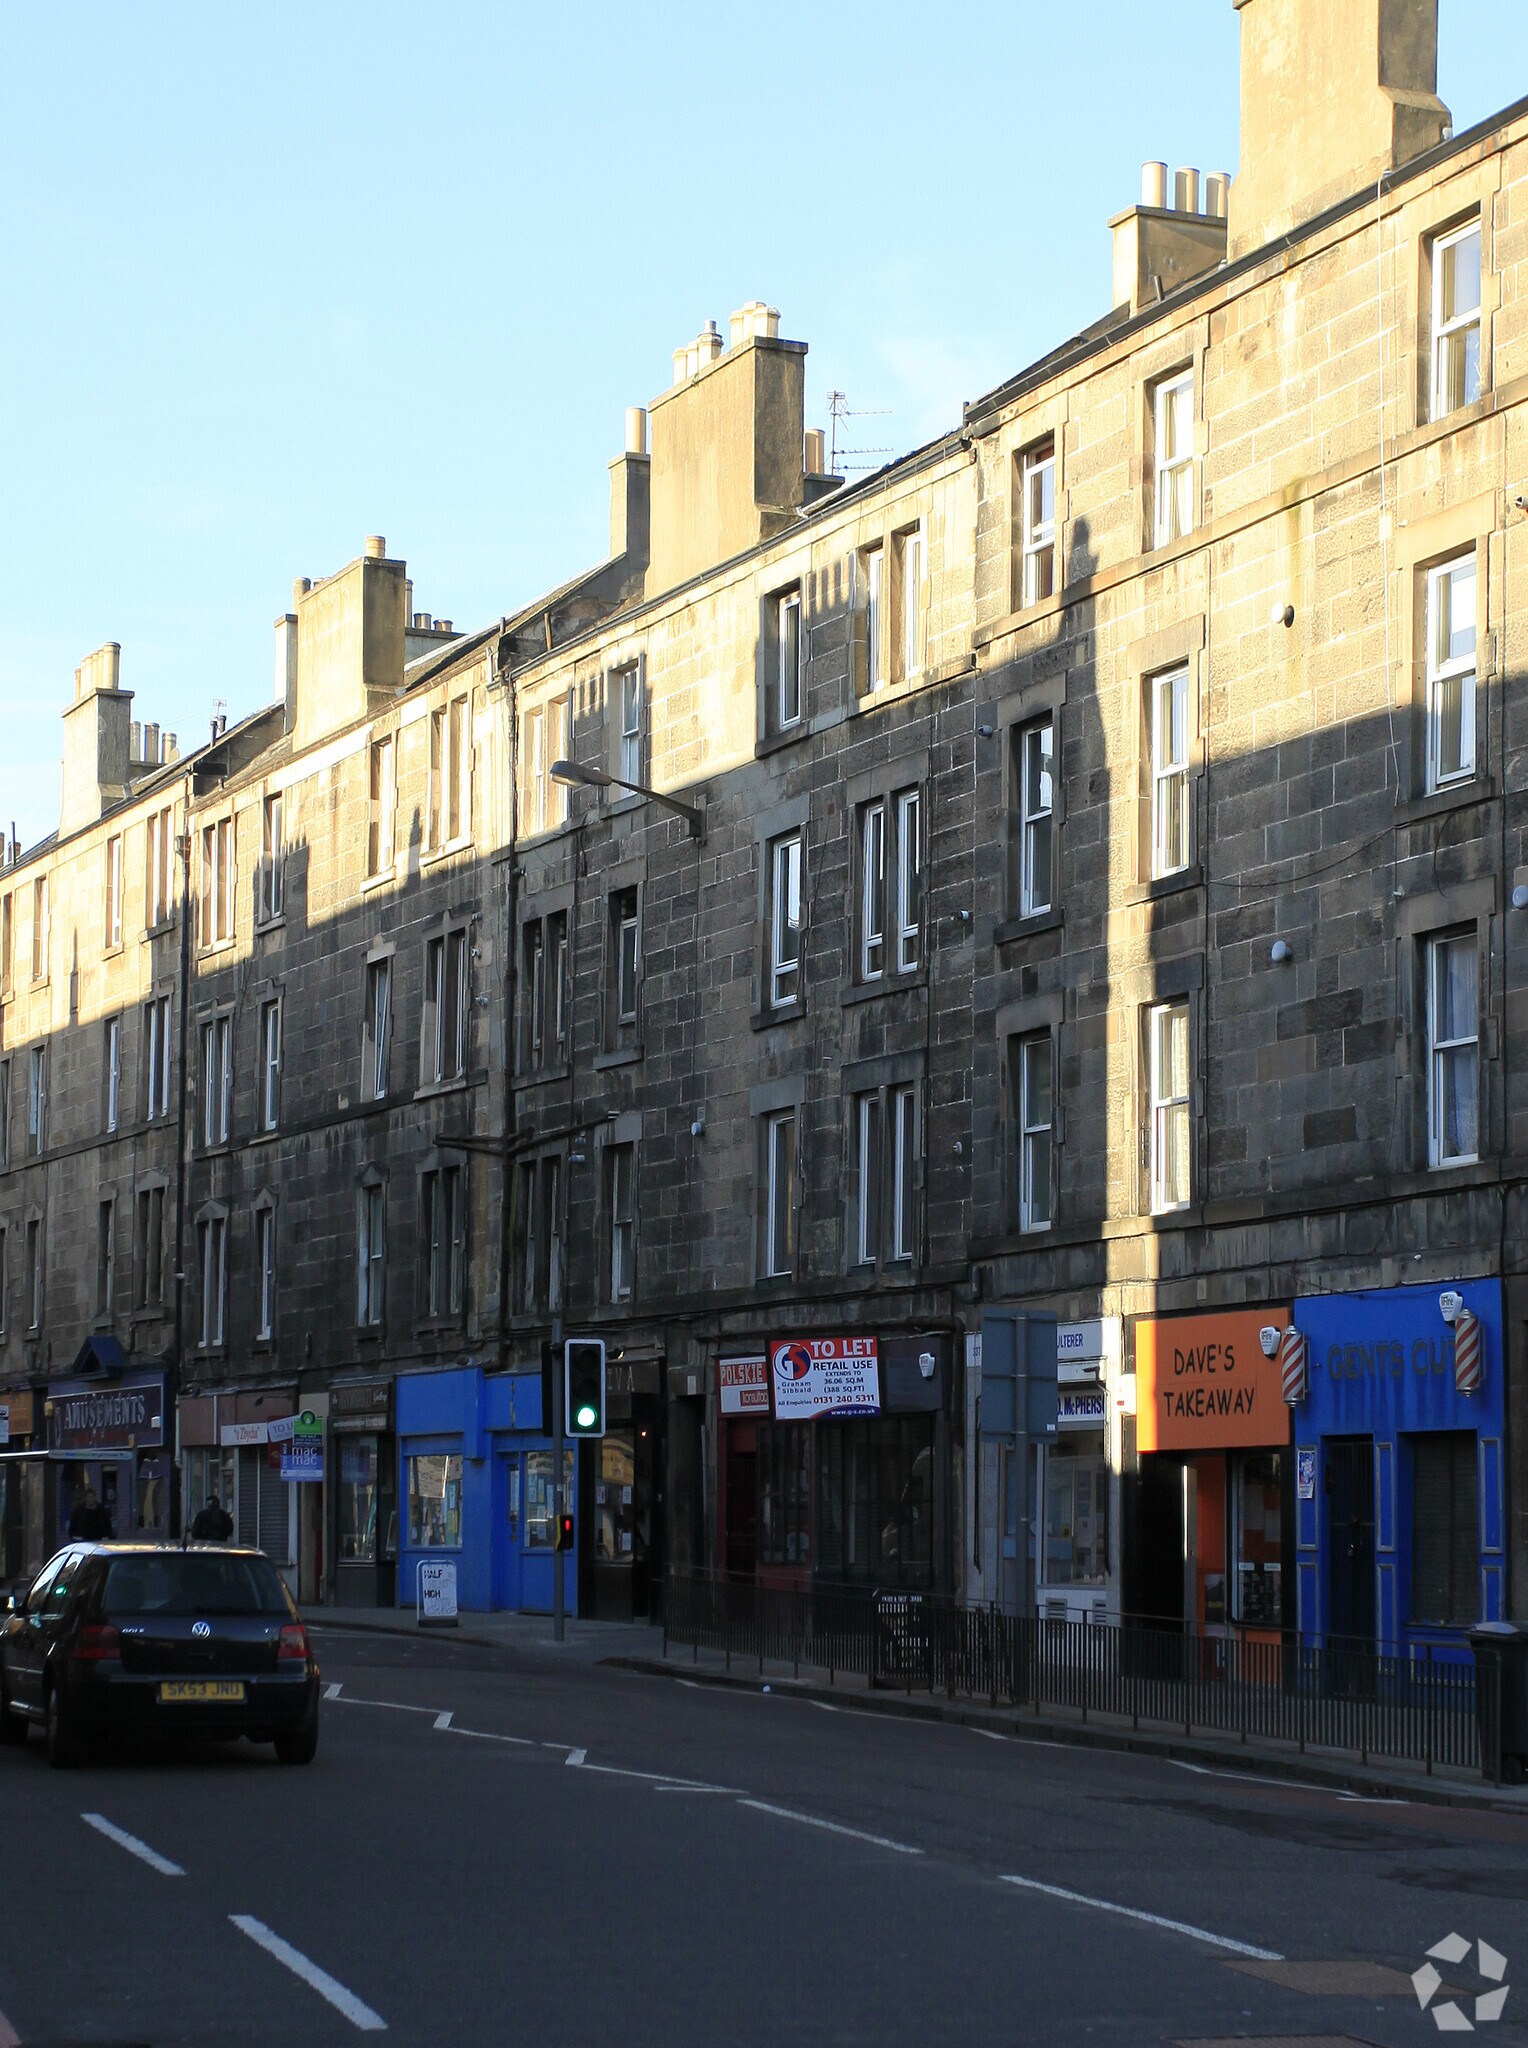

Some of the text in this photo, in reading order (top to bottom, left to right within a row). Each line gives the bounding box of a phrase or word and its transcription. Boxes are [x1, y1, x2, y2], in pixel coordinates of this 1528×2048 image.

[810, 1338, 873, 1358] TO LET
[813, 1360, 873, 1371] RETAIL USE
[1174, 1344, 1235, 1375] DAVE'S
[1328, 1339, 1405, 1380] GENTS
[720, 1363, 763, 1385] POLSKIE
[813, 1394, 875, 1404] 0131 240 5311
[1064, 1394, 1104, 1416] McPHERS
[1163, 1387, 1255, 1417] TAKEAWAY
[64, 1394, 145, 1430] AMUSEMENTS
[831, 1408, 876, 1416] www.g-s.co.uk
[273, 1424, 285, 1434] TO
[291, 1446, 317, 1456] mac
[291, 1455, 317, 1466] mac
[424, 1569, 443, 1579] HALF
[424, 1589, 441, 1599] HIGH
[168, 1681, 207, 1696] SK53
